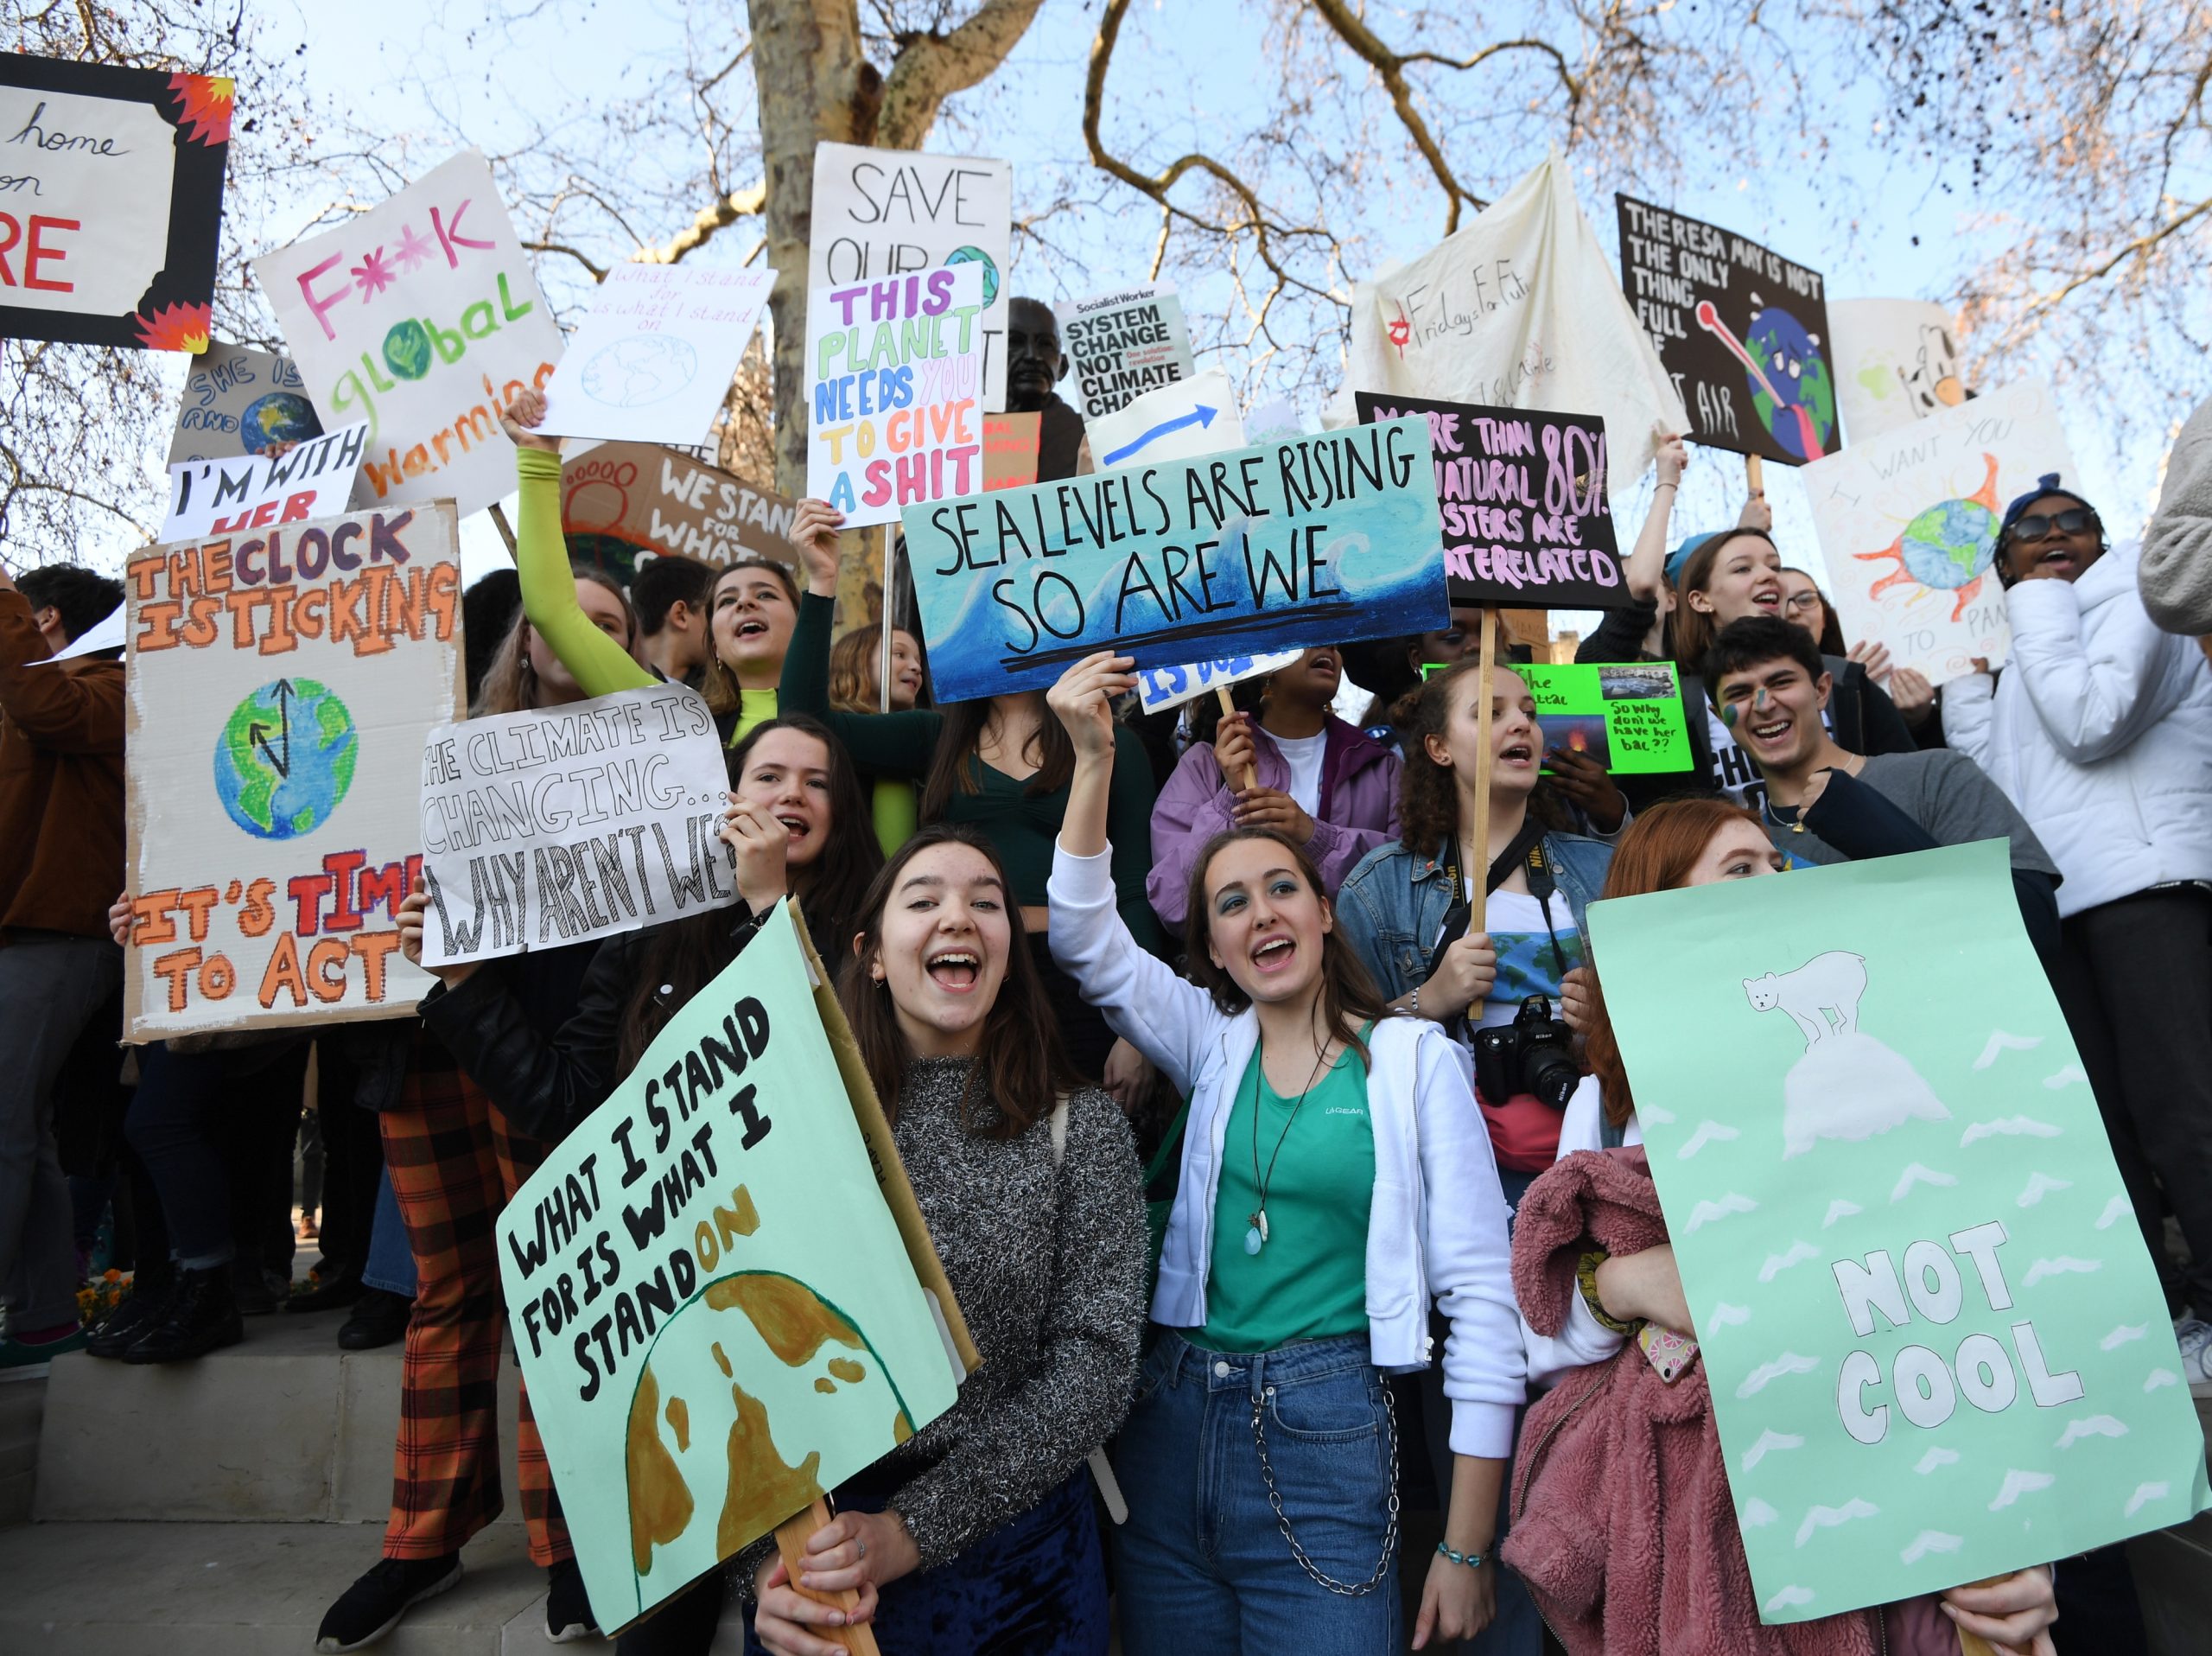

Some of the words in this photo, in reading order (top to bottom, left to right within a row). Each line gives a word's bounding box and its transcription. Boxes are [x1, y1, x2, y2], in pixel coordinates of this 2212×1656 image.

[7, 101, 134, 156] home
[848, 162, 993, 227] SAVE
[1624, 201, 1726, 260] THERESA
[1731, 239, 1764, 276] MAY
[1765, 252, 1782, 283] IS
[1786, 264, 1821, 301] NOT
[1628, 235, 1673, 273] THE
[1679, 250, 1729, 290] ONLY
[830, 270, 955, 327] THIS
[1077, 296, 1121, 315] Socialist
[1119, 288, 1156, 304] Worker
[1632, 265, 1696, 309] THING
[1637, 298, 1688, 340] FULL
[638, 320, 662, 331] on
[817, 304, 981, 380] PLANET
[1065, 303, 1160, 341] SYSTEM
[1071, 322, 1171, 358] CHANGE
[188, 356, 256, 406] SHE
[815, 365, 914, 424] NEEDS
[919, 353, 976, 405] YOU
[1076, 352, 1123, 378] NOT
[1081, 362, 1182, 398] CLIMATE
[181, 407, 240, 433] AND
[818, 419, 876, 466] TO
[886, 398, 976, 454] GIVE
[1471, 417, 1536, 457] THAN
[1697, 380, 1739, 442] AIR
[175, 463, 255, 518] I'M
[262, 424, 368, 494] WITH
[828, 470, 856, 513] A
[861, 444, 981, 507] SHIT
[1435, 455, 1538, 509] ATURAL
[1541, 424, 1611, 518] 80%
[1830, 481, 1862, 507] I
[1869, 435, 1944, 481] WANT
[1963, 417, 2014, 448] YOU
[660, 456, 716, 511] WE
[715, 483, 795, 539] STAN
[702, 517, 740, 541] FOR
[931, 499, 1033, 576] SEA
[1033, 468, 1171, 558] LEVELS
[1185, 455, 1270, 531] ARE
[1278, 425, 1416, 519] RISING
[1532, 512, 1583, 546] ARE
[127, 539, 233, 598] THE
[234, 508, 416, 587] CLOCK
[650, 508, 759, 567] WHAT
[136, 596, 223, 653] IS
[225, 561, 459, 657] TICKING
[991, 570, 1085, 654] SO
[1114, 540, 1236, 635] ARE
[1242, 524, 1342, 610] WE
[1903, 629, 1936, 656] TO
[467, 702, 646, 777] CLIMATE
[651, 695, 711, 742] IS
[1611, 701, 1631, 715] So
[1612, 725, 1649, 736] have
[1653, 726, 1676, 738] her
[422, 753, 728, 856] CHANGING...
[131, 877, 276, 949] IT'S
[423, 850, 527, 958] WHY
[533, 825, 657, 944] AREN'T
[153, 946, 237, 1013] TO
[258, 931, 403, 1010] ACT
[1557, 1082, 1568, 1102] Nikon
[507, 1153, 601, 1281] WHAT
[611, 1115, 647, 1189] I
[645, 996, 771, 1154] STAND
[520, 1272, 580, 1358] FOR
[577, 1230, 621, 1307] IS
[621, 1121, 718, 1252] WHAT
[728, 1082, 772, 1150] I
[574, 1248, 696, 1402] STAND
[695, 1182, 761, 1273] ON
[1830, 1220, 2014, 1338] NOT
[1836, 1320, 2085, 1445] COOL
